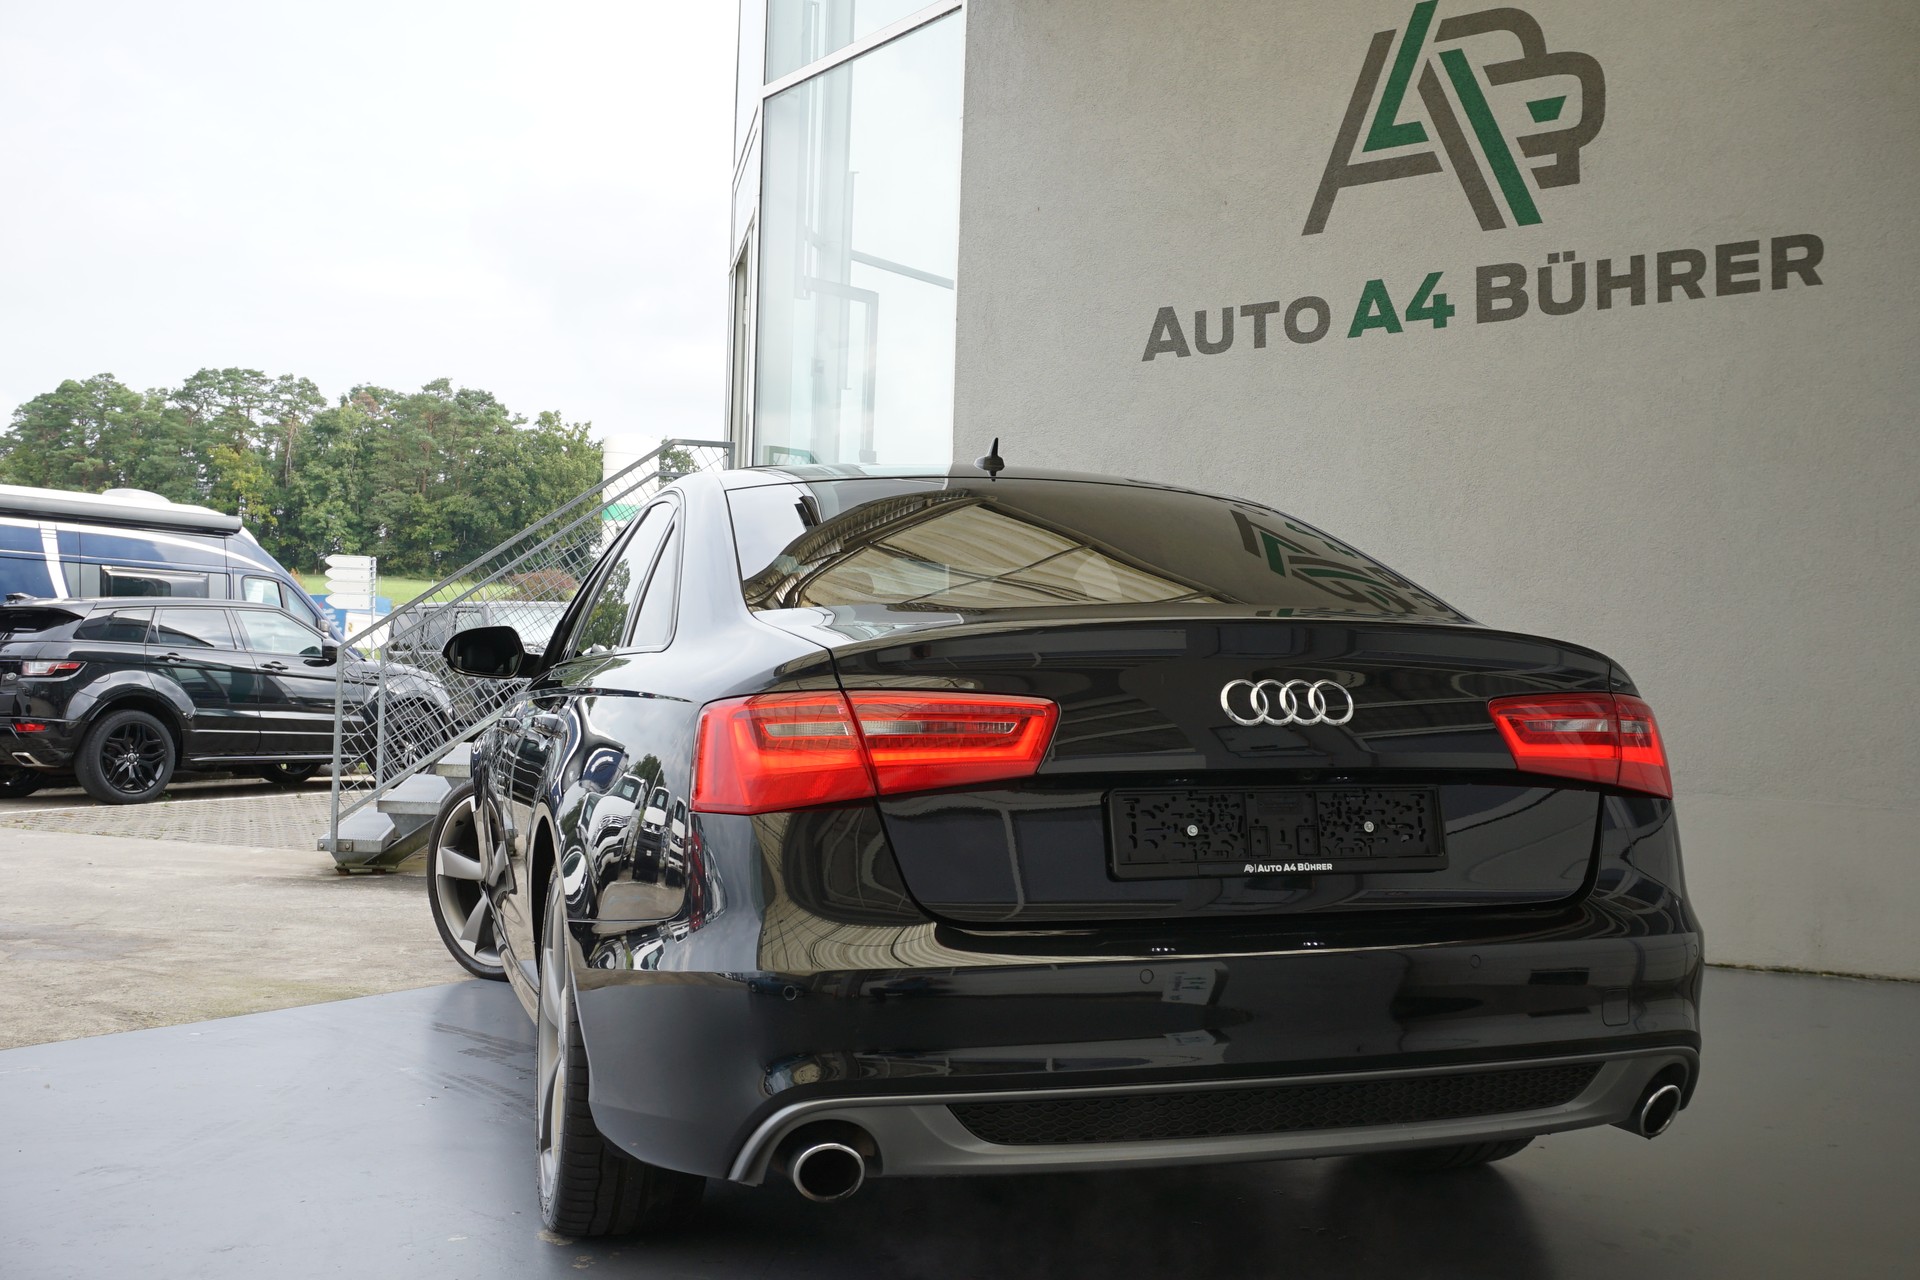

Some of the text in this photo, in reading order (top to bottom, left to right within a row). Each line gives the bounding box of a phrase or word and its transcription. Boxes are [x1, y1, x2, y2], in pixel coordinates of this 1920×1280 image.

[1142, 233, 1825, 361] AUTO A4 BÜHRER
[1257, 864, 1283, 873] AUTO
[1283, 863, 1297, 872] A4
[1297, 862, 1333, 872] BÜHRER
